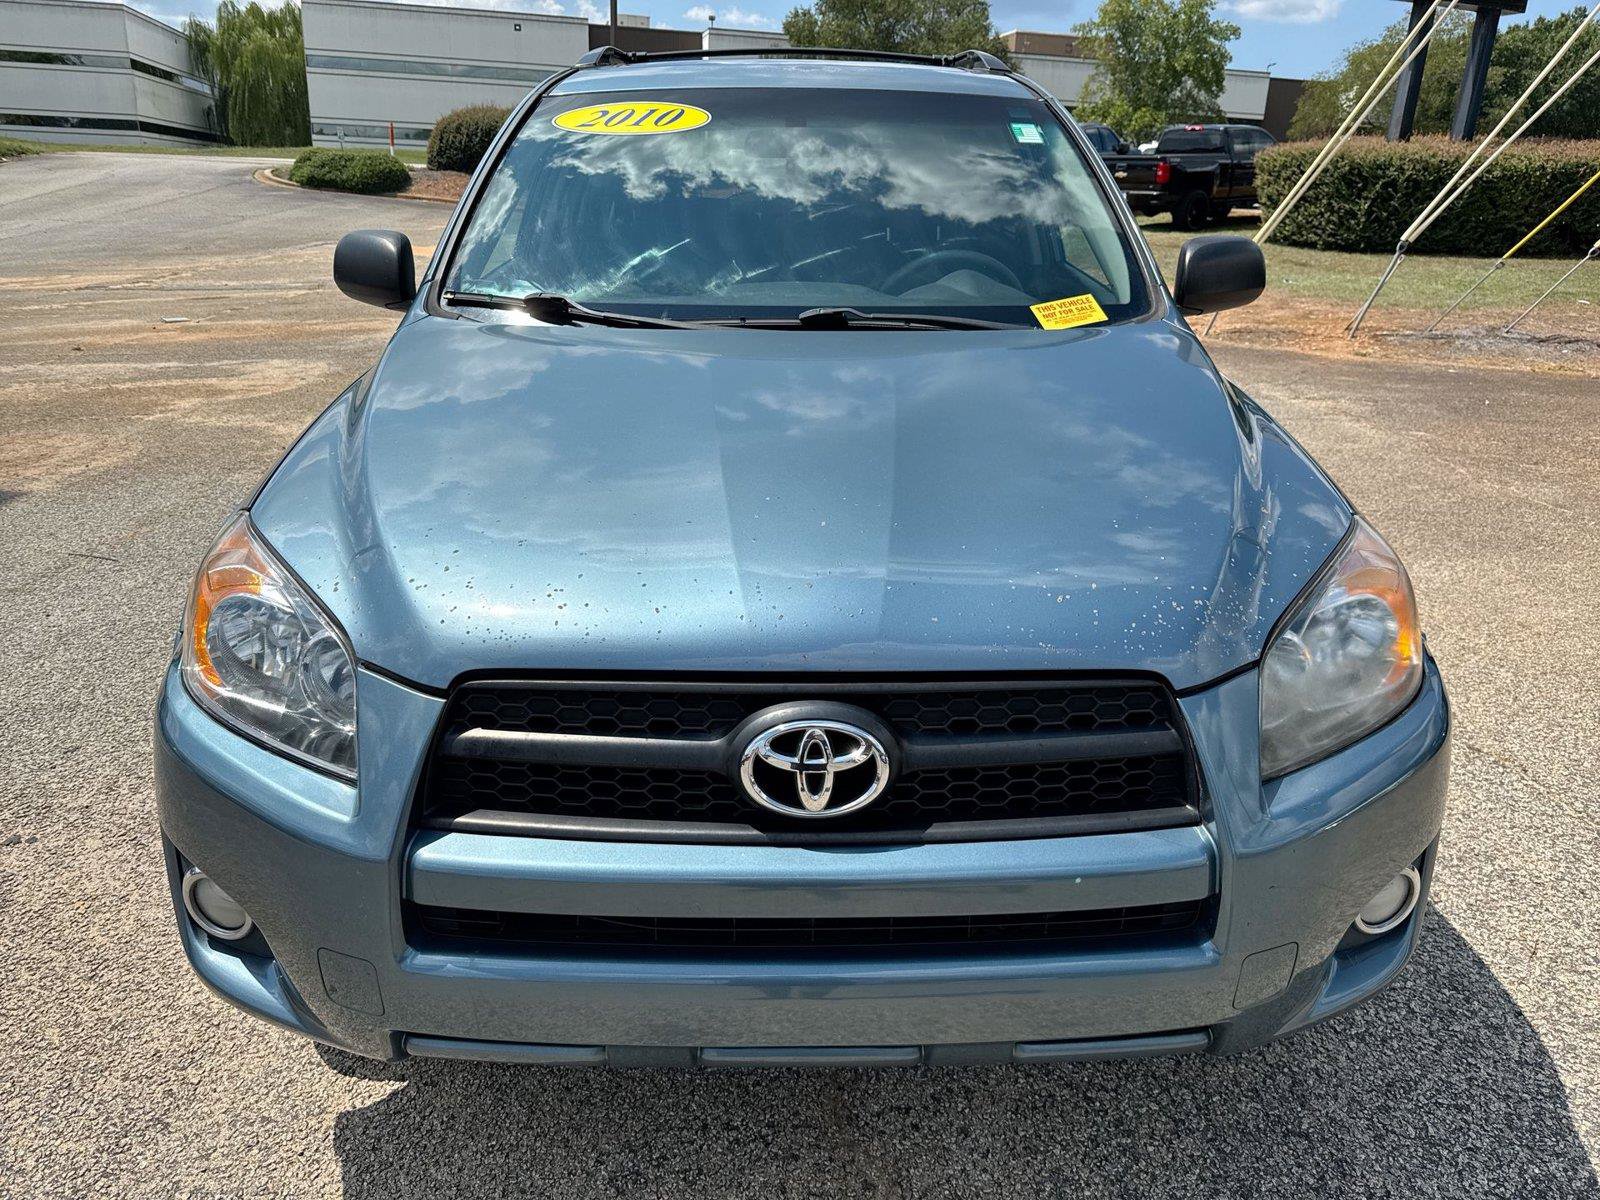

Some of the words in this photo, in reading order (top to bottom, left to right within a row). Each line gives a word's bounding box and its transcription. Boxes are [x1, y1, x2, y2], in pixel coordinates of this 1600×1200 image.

[576, 108, 685, 128] 2010
[1036, 304, 1056, 313] THIS
[1057, 297, 1092, 309] VEHICLE
[1043, 311, 1057, 319] NOT
[1059, 308, 1074, 316] FOR
[1075, 304, 1095, 313] SALE
